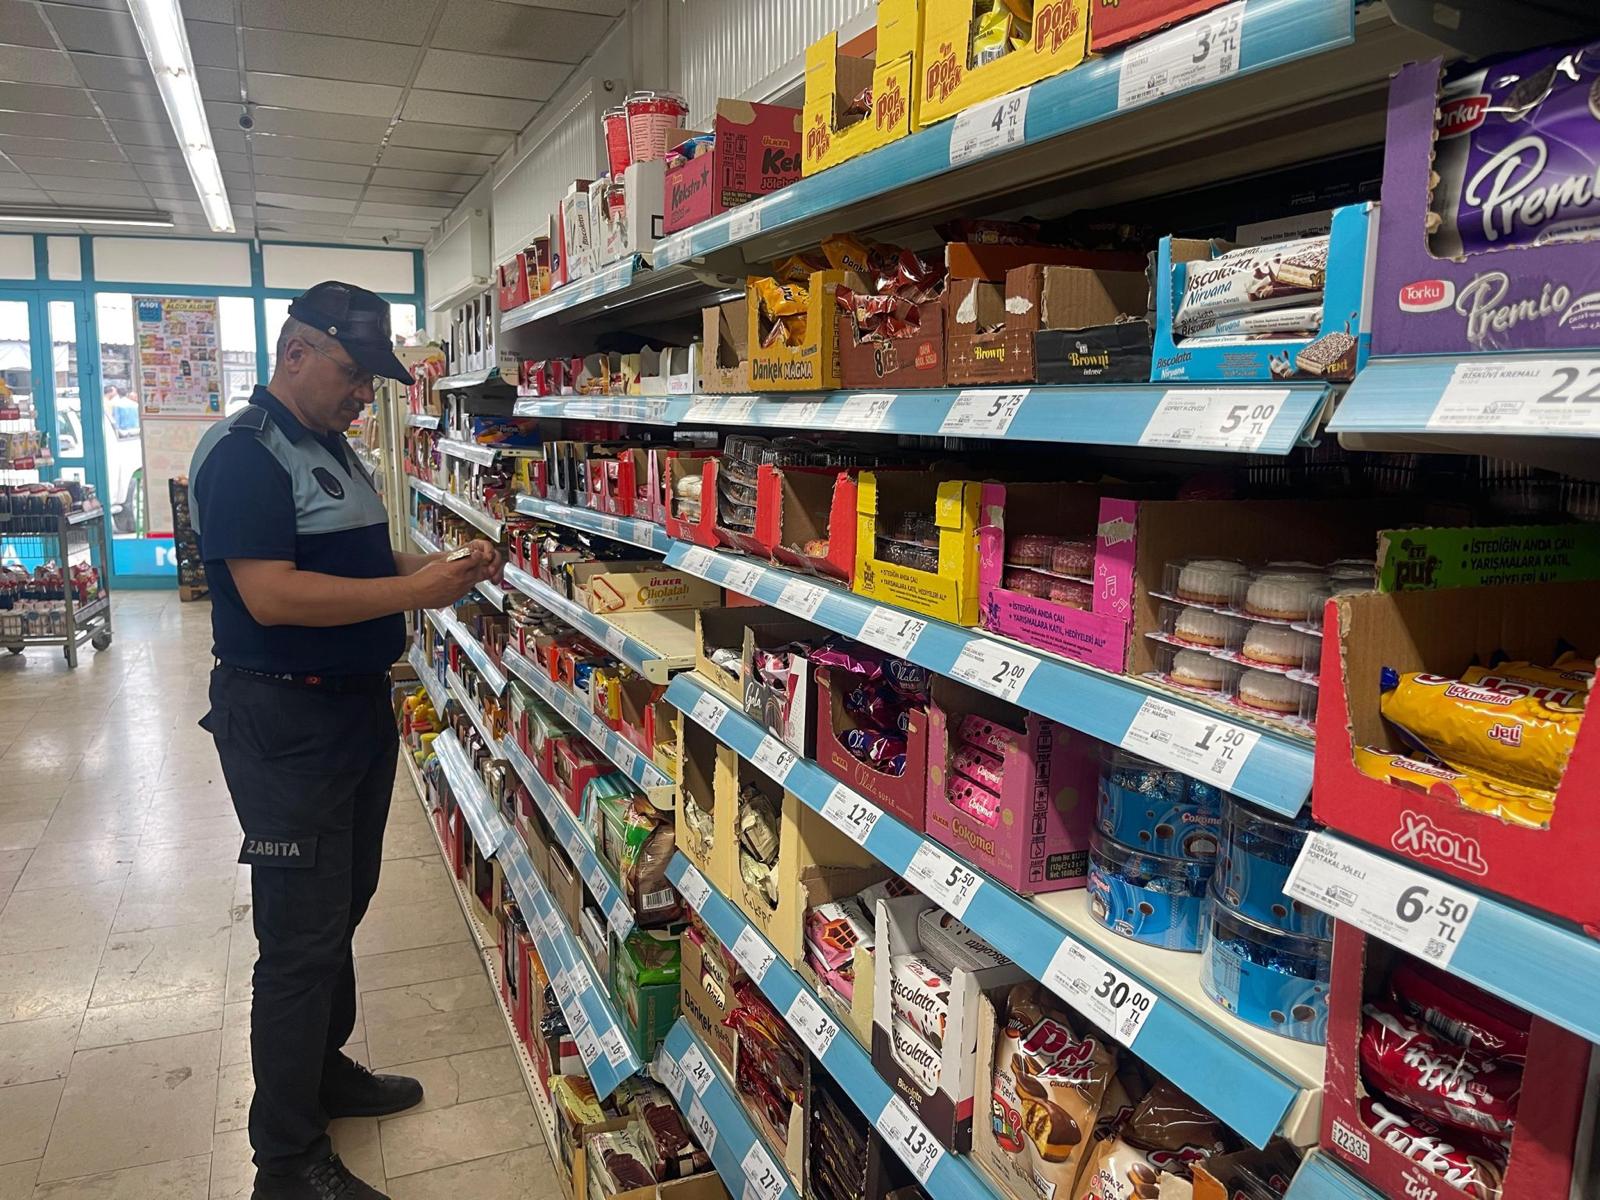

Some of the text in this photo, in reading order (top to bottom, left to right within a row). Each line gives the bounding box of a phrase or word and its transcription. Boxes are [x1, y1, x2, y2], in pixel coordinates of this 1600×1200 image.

[1222, 38, 1237, 53] TL
[991, 98, 1021, 132] 4,50
[1440, 104, 1481, 130] orku
[1407, 286, 1440, 300] Torku
[1456, 271, 1570, 340] Premio
[987, 394, 1024, 418] 5,75
[1220, 404, 1275, 434] 5,00
[1250, 423, 1264, 434] TL
[650, 576, 682, 587] ÜLKER
[992, 660, 1025, 684] 2,00
[1007, 678, 1016, 690] TL
[1195, 723, 1245, 751] 1,90
[1221, 745, 1234, 760] TL
[847, 803, 877, 826] 12,00
[247, 840, 300, 857] ZABITA
[1397, 816, 1483, 870] XROLL
[945, 865, 975, 888] 5,50
[959, 886, 967, 898] TL
[1396, 885, 1469, 924] 6,50
[1435, 920, 1457, 943] TL
[1094, 970, 1150, 1012] 30,00
[815, 1017, 836, 1038] 3,00
[1128, 1008, 1140, 1025] TL
[903, 1124, 938, 1160] 13,50
[1336, 1126, 1368, 1161] 22335
[760, 1167, 783, 1195] 27,50
